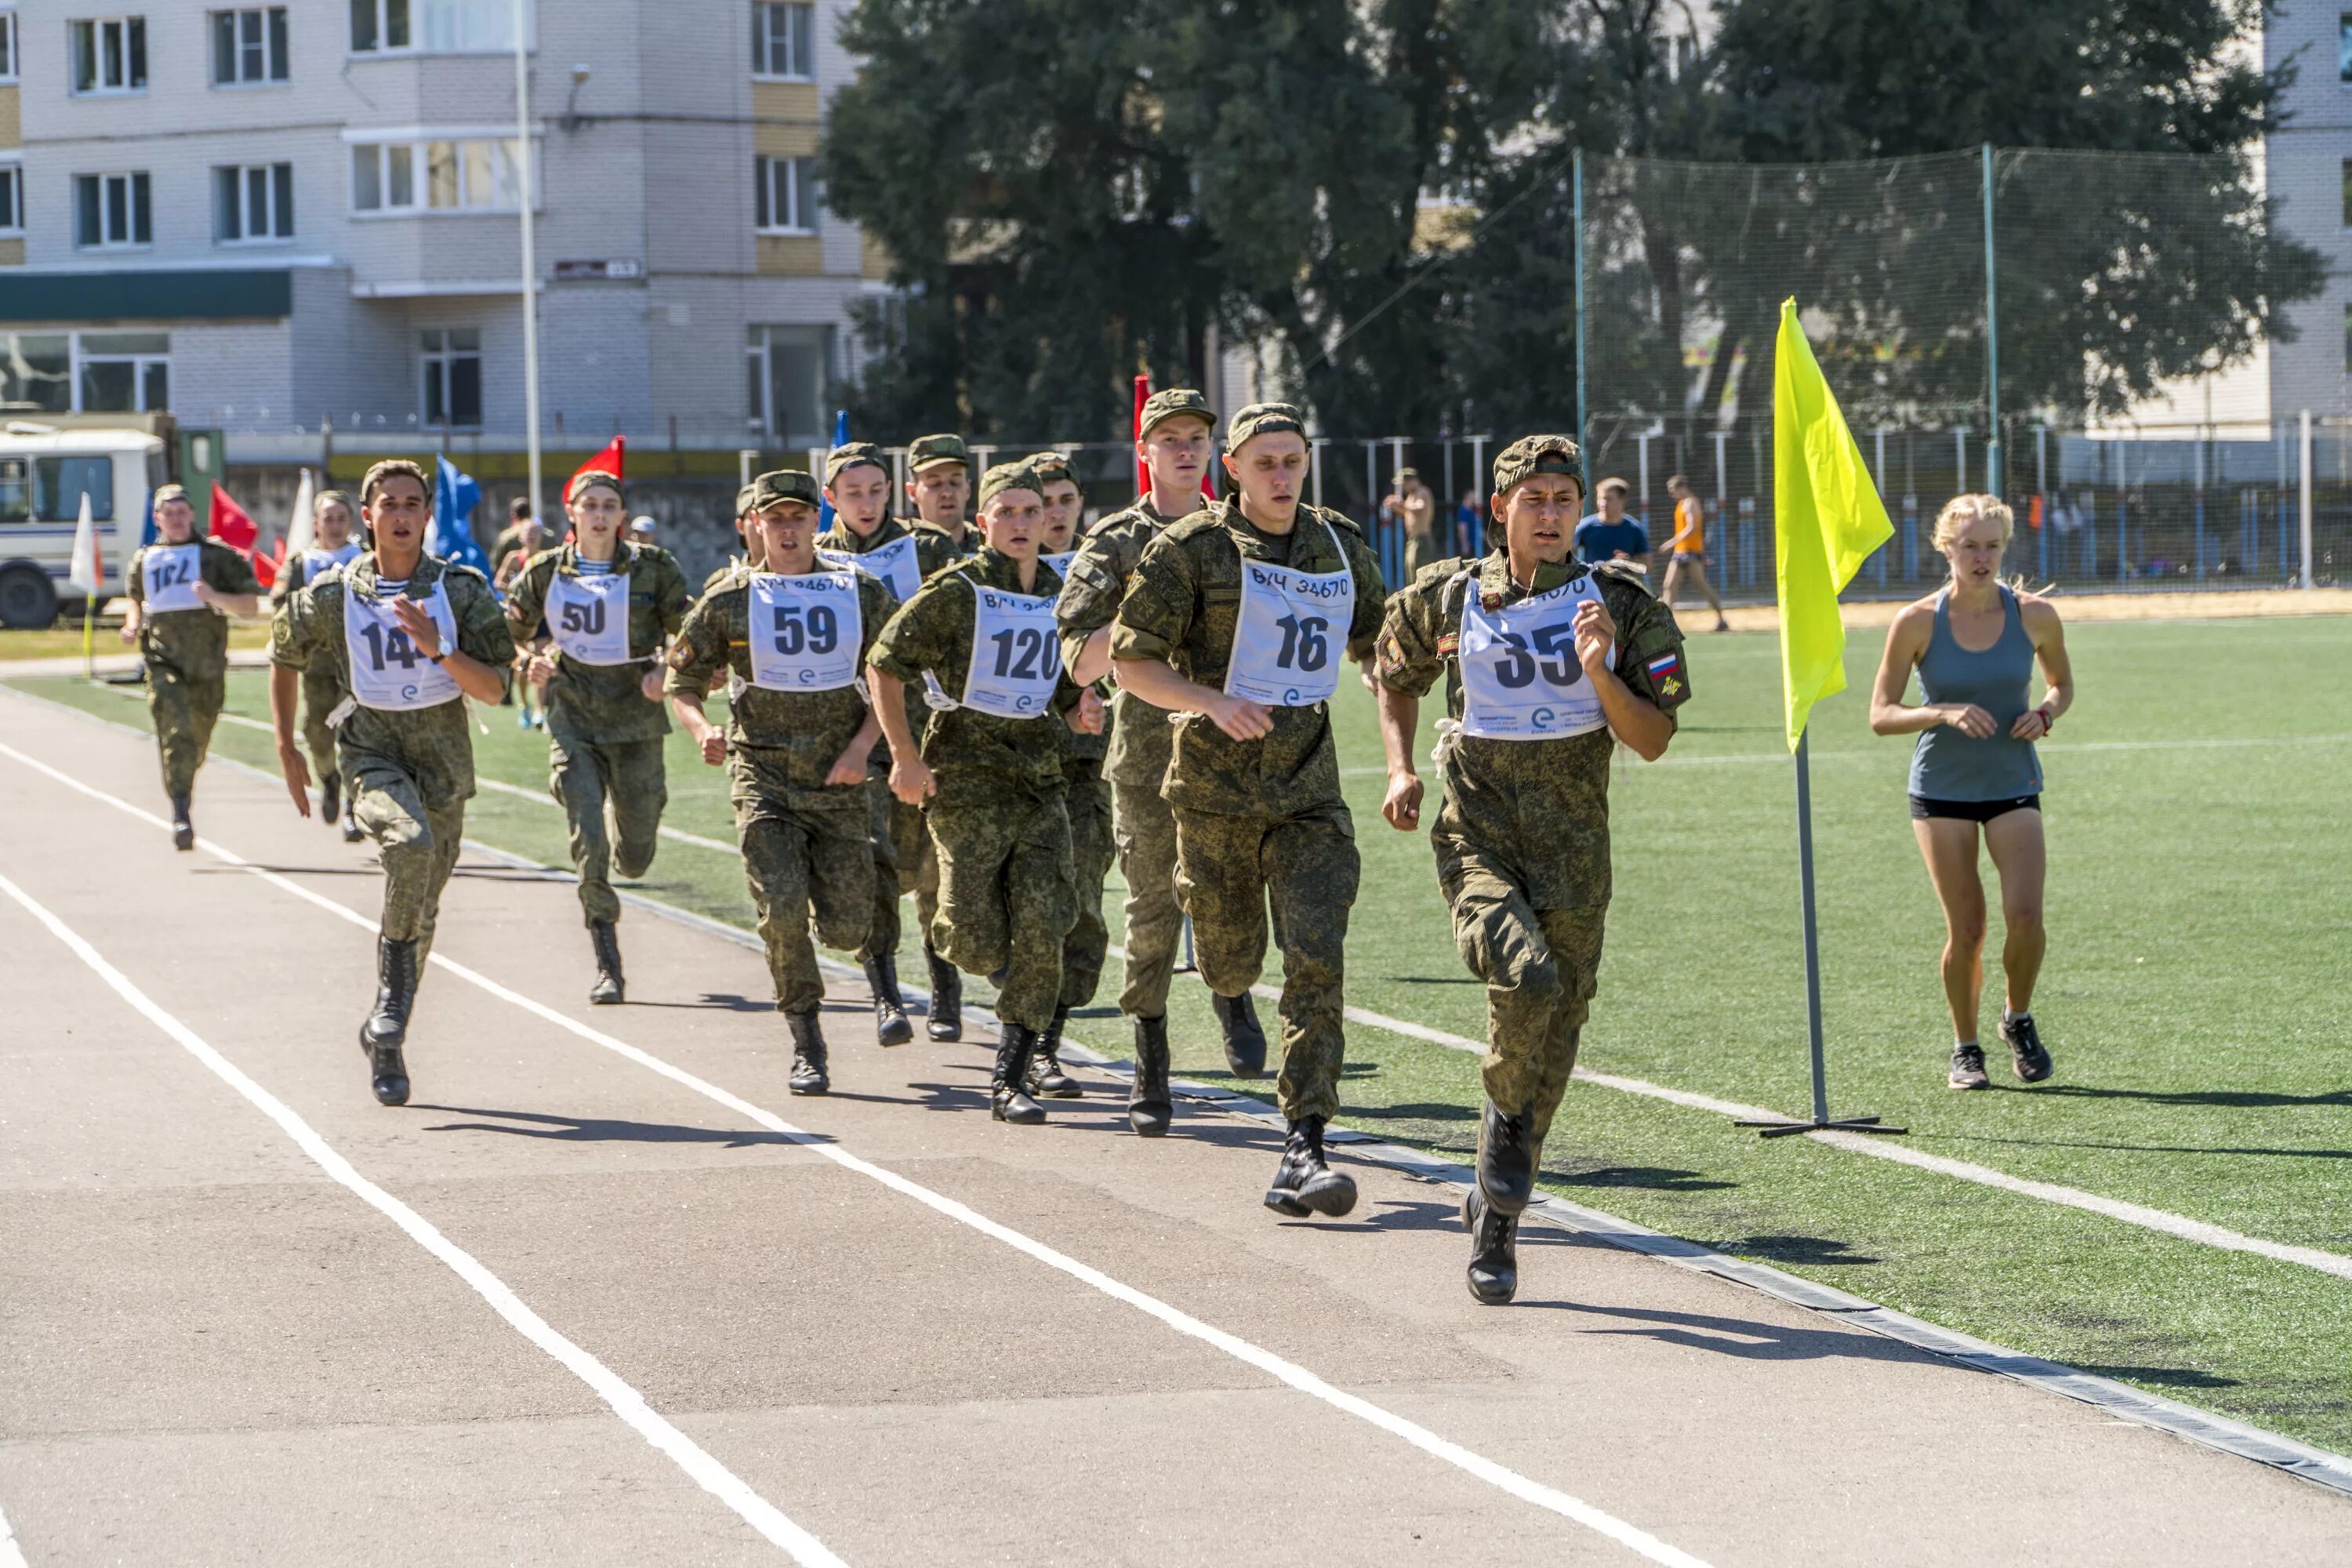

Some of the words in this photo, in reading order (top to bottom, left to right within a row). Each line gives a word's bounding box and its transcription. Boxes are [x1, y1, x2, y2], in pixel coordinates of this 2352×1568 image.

[1296, 579, 1348, 598] 34670
[561, 597, 605, 635] 50
[774, 606, 837, 655] 59
[991, 628, 1061, 681] 120
[1276, 613, 1329, 673] 16
[1490, 622, 1583, 688] 35
